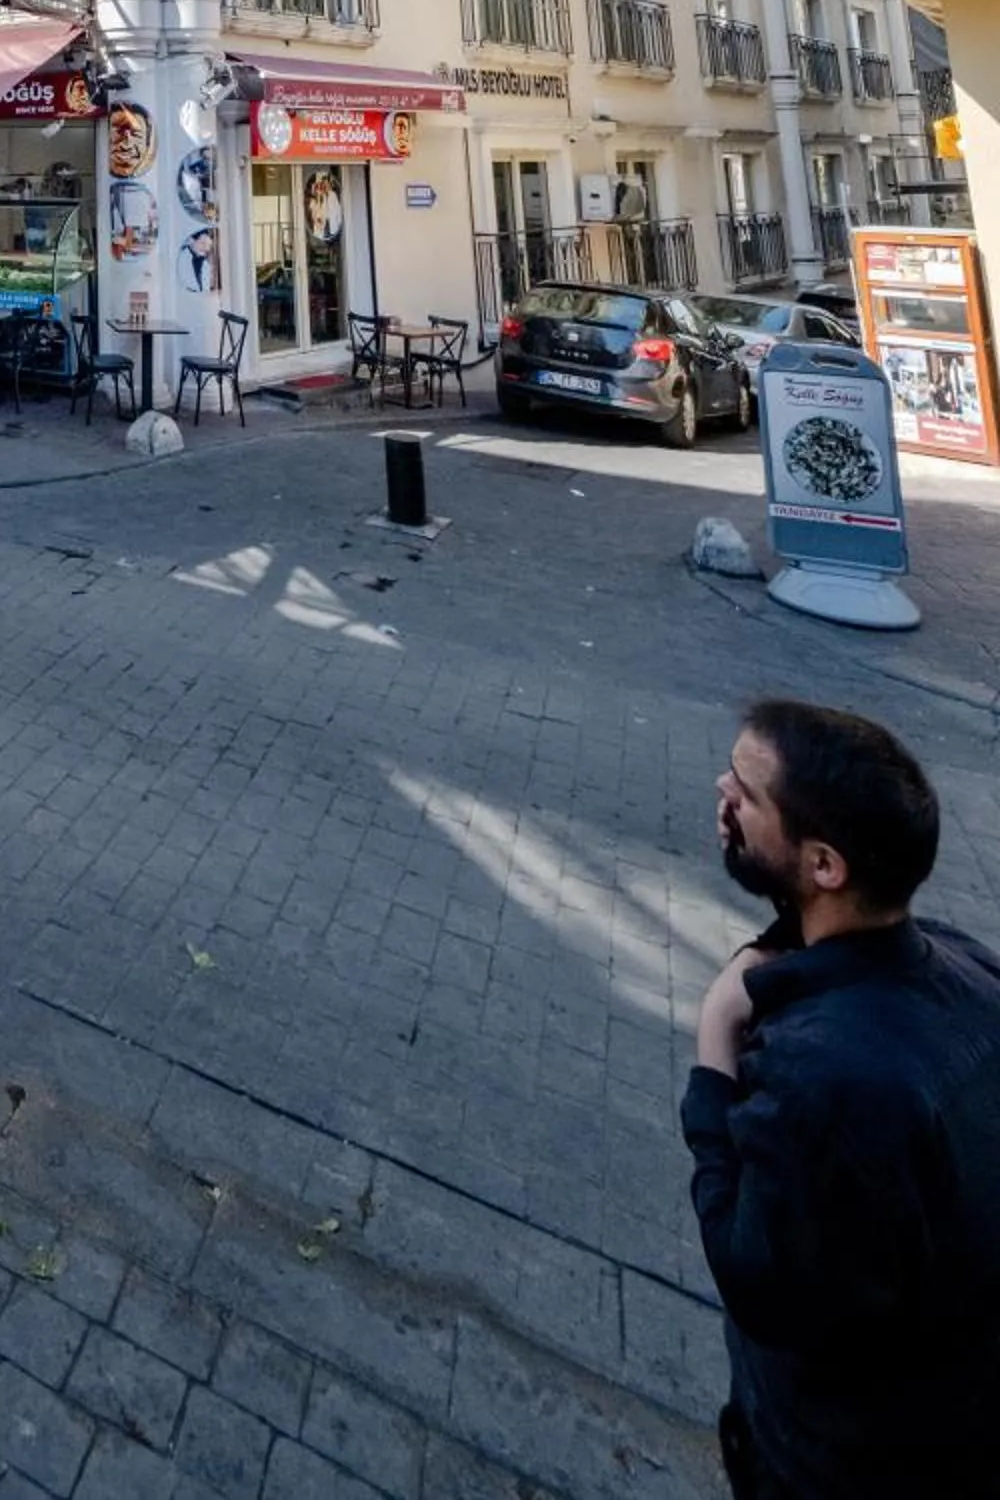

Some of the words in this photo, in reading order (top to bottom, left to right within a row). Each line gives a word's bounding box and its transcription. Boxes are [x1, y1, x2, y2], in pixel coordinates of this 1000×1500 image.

[480, 63, 532, 97] BEYOĞLU
[533, 73, 566, 99] HOTEL
[300, 128, 337, 143] KELLE
